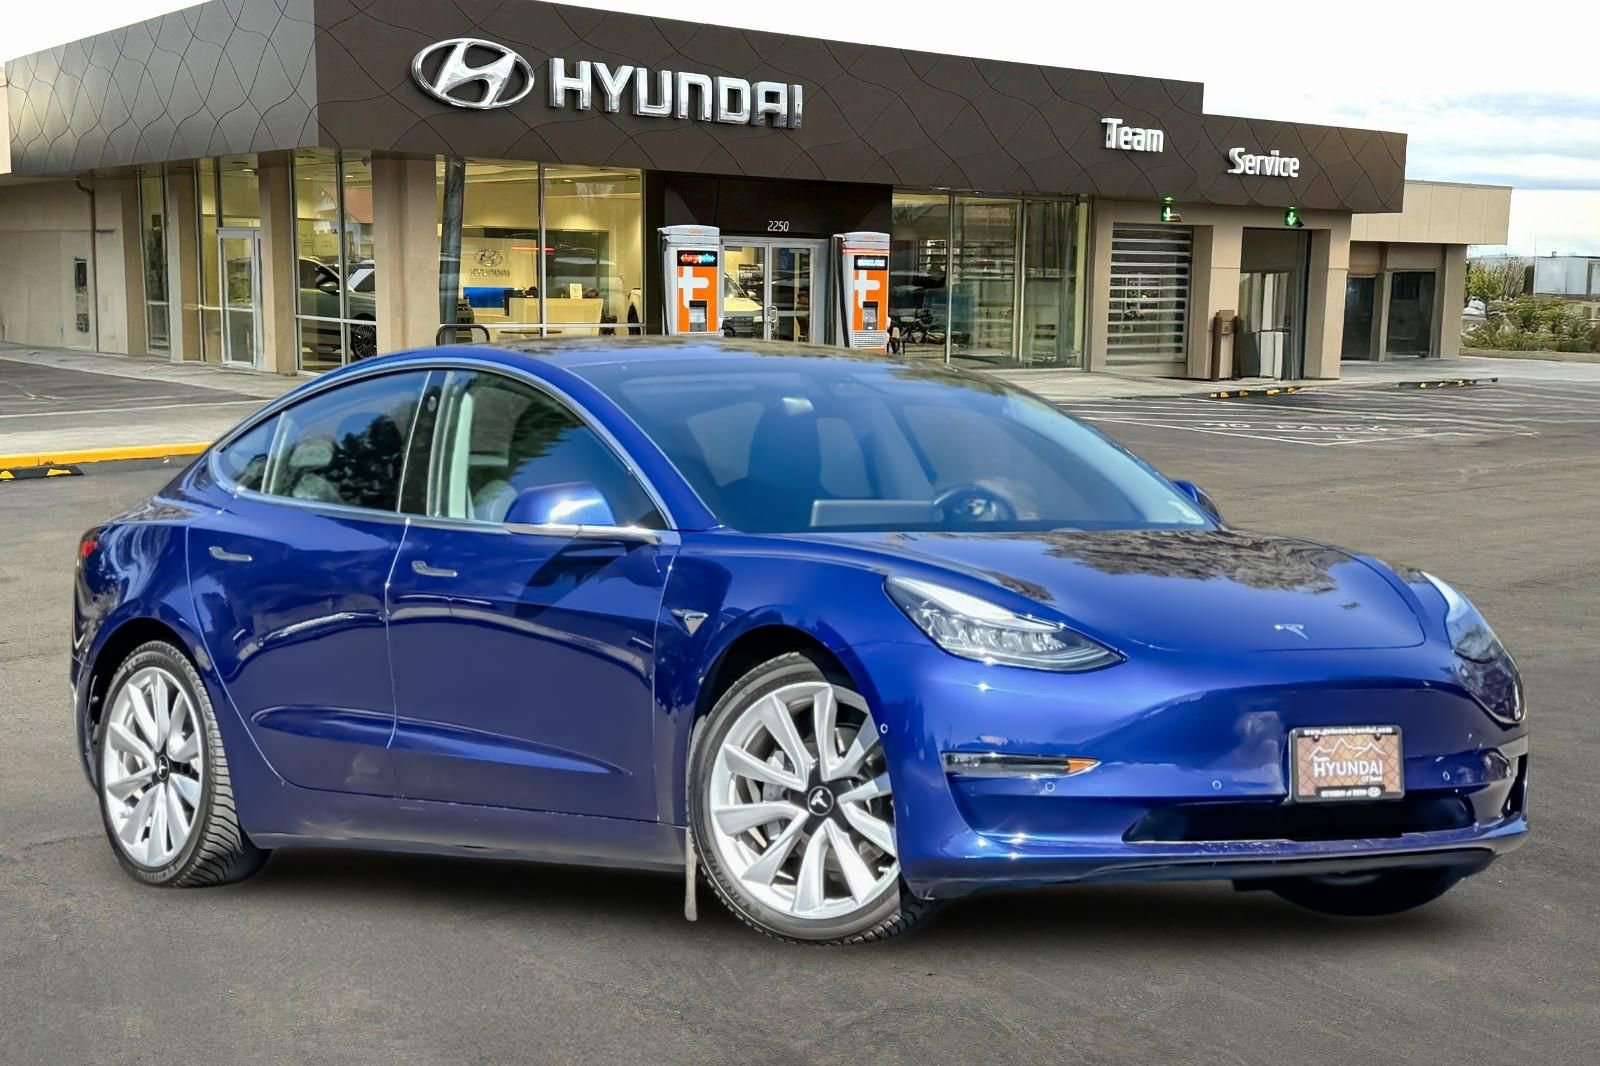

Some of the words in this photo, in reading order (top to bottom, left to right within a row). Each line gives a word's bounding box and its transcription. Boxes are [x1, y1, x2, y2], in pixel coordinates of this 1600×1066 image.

[549, 57, 802, 129] HYUNDAI
[1101, 117, 1164, 153] Team
[1227, 147, 1300, 178] Service
[767, 220, 790, 232] 2250
[1314, 760, 1383, 777] HYUNDAI
